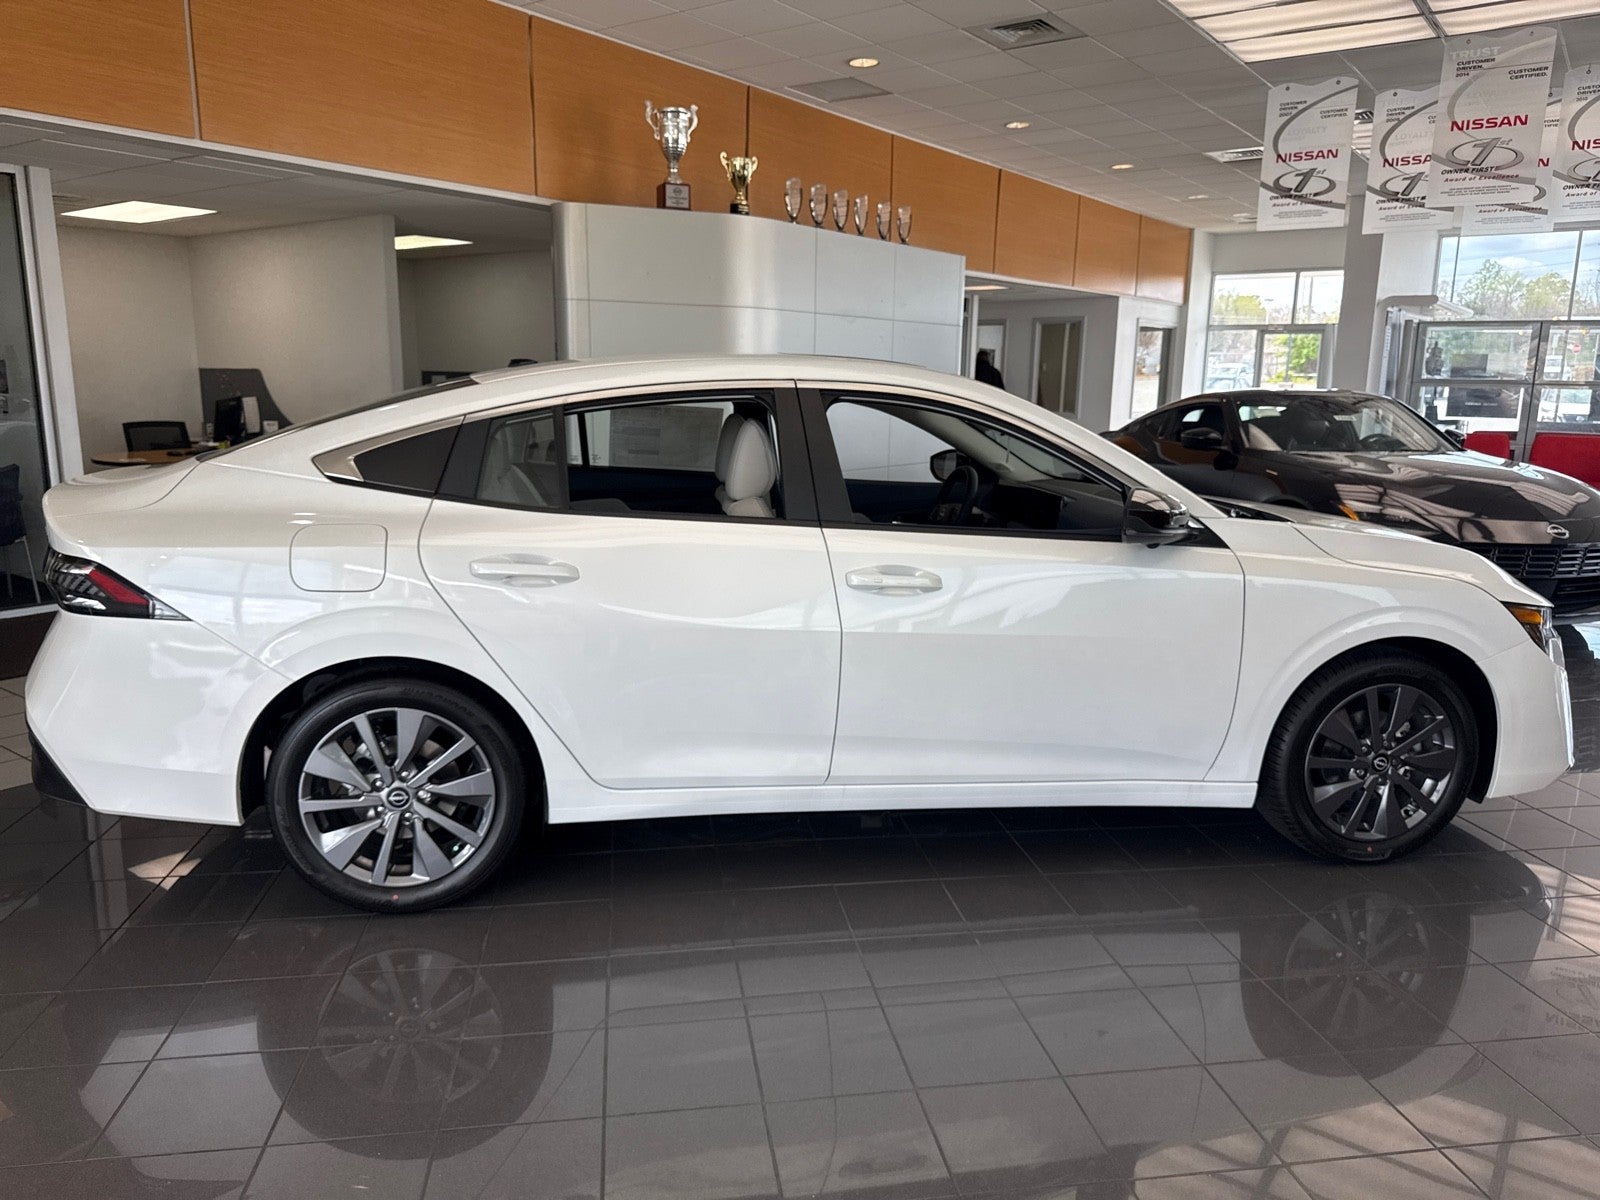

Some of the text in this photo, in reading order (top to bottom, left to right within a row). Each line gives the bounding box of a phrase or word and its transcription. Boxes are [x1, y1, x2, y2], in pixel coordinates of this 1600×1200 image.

[1450, 46, 1501, 59] TRUST
[1457, 57, 1496, 66] CUSTOMER
[1456, 64, 1484, 72] DRIVEN.
[1508, 66, 1549, 75] CUSTOMER
[1509, 72, 1548, 80] CERTIFIED.
[1450, 114, 1529, 132] NISSAN
[1571, 138, 1600, 151] NIS
[1275, 148, 1339, 163] NISSAN
[1382, 154, 1432, 168] NISSA
[1441, 167, 1470, 175] OWNER
[1562, 183, 1591, 191] OWNER
